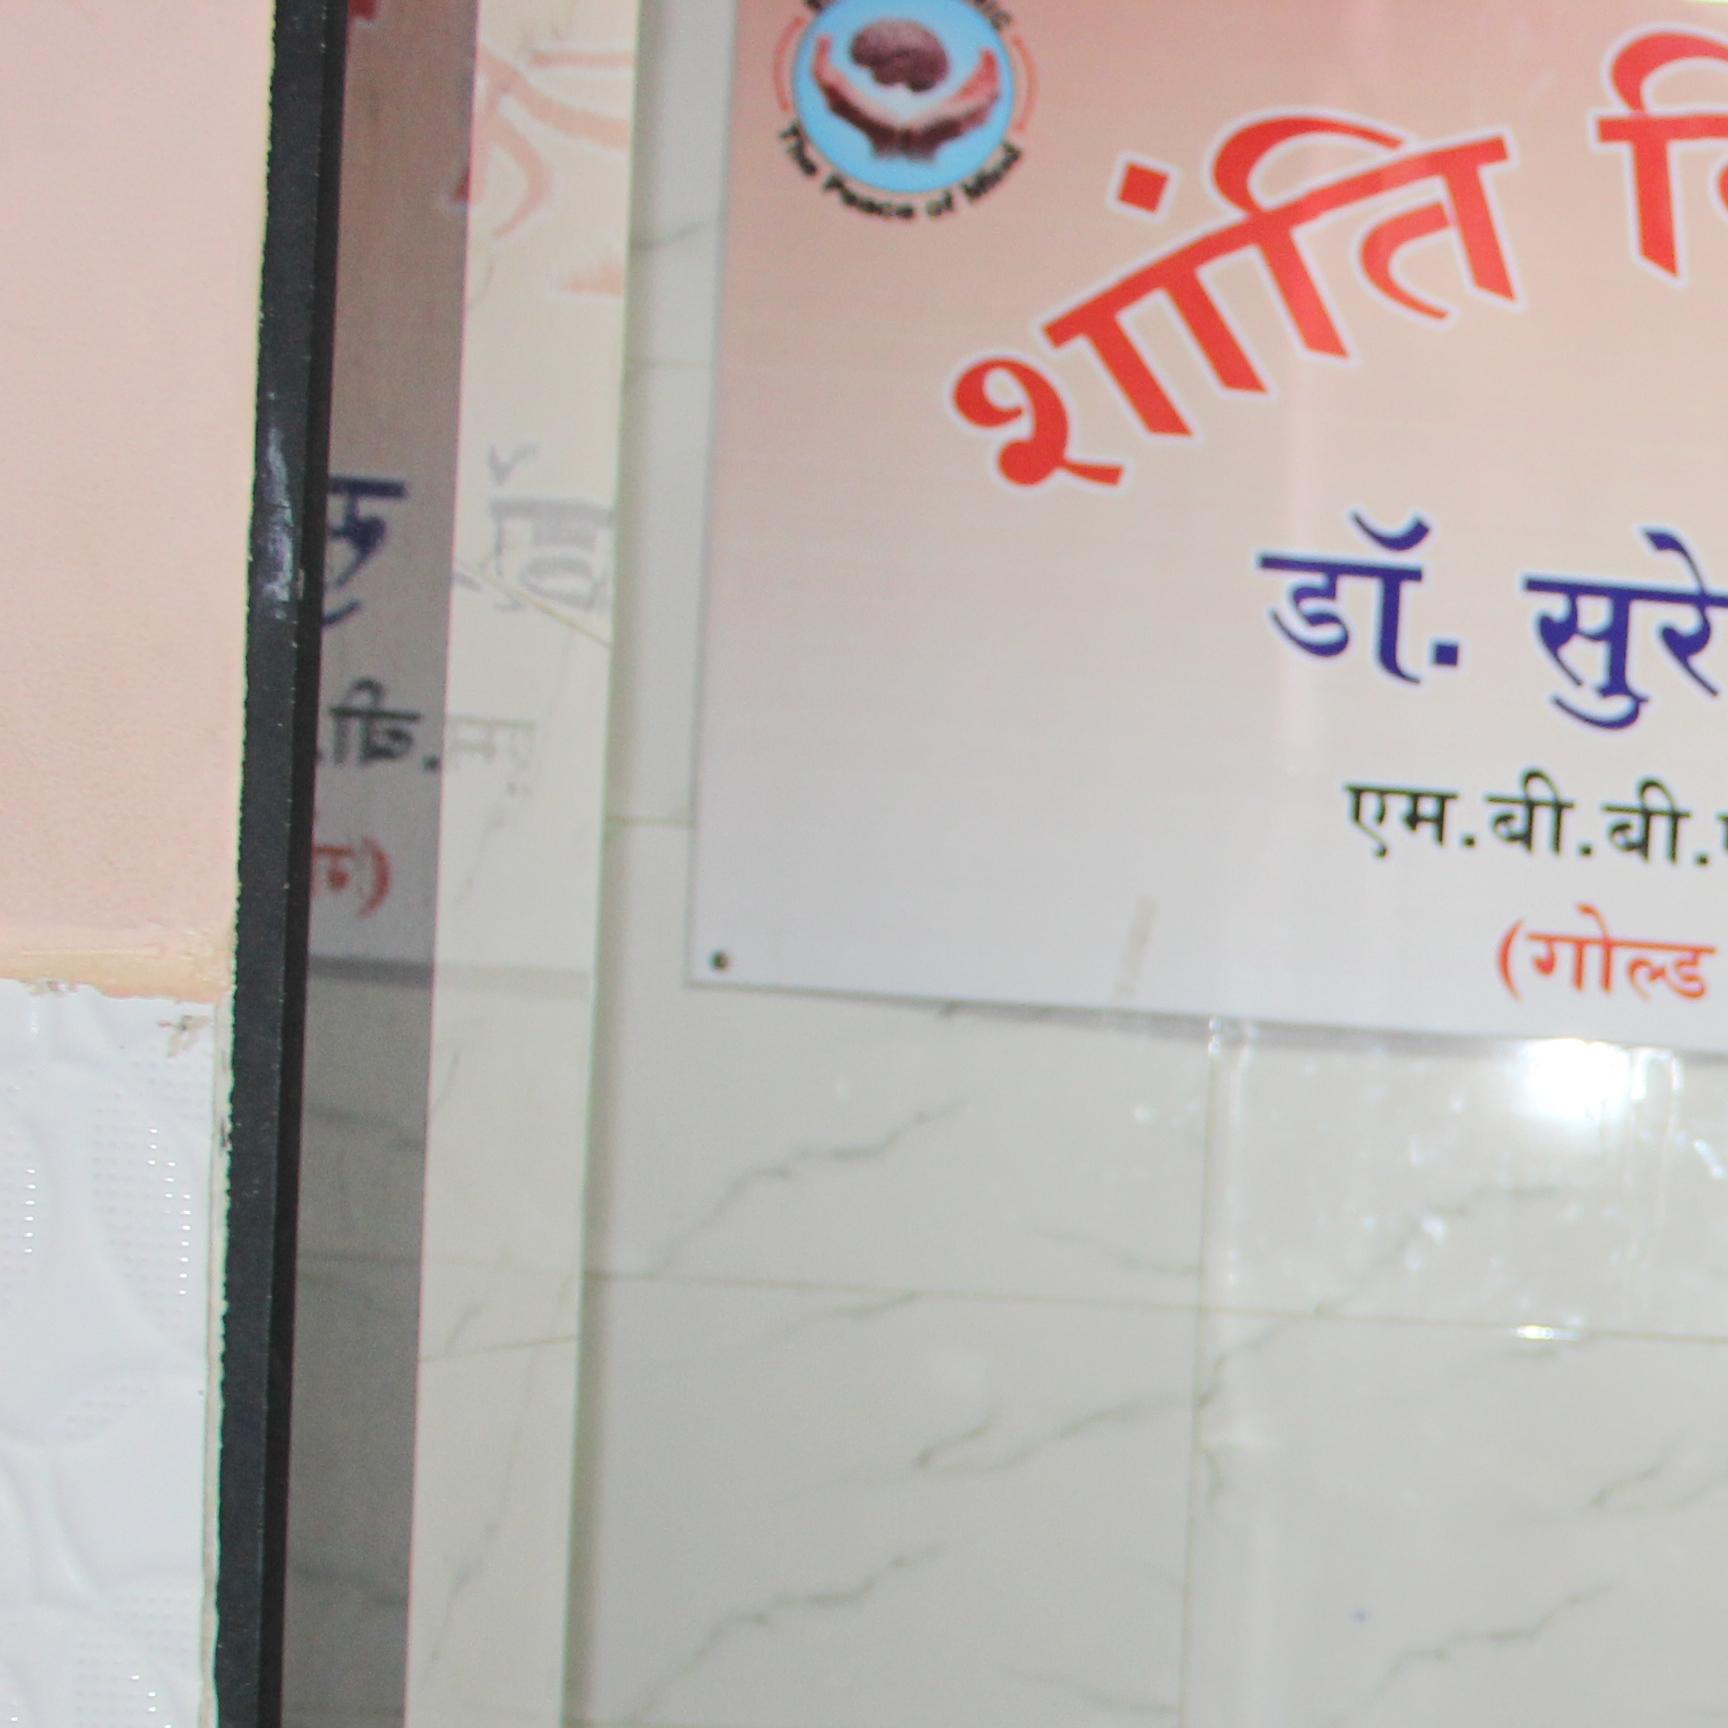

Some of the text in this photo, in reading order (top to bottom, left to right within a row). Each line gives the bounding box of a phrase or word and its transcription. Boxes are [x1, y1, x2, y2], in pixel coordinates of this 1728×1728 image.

[952, 113, 1520, 487] शांति
[1258, 513, 1459, 684] डॉ.
[1499, 902, 1717, 999] (गोल्ड
